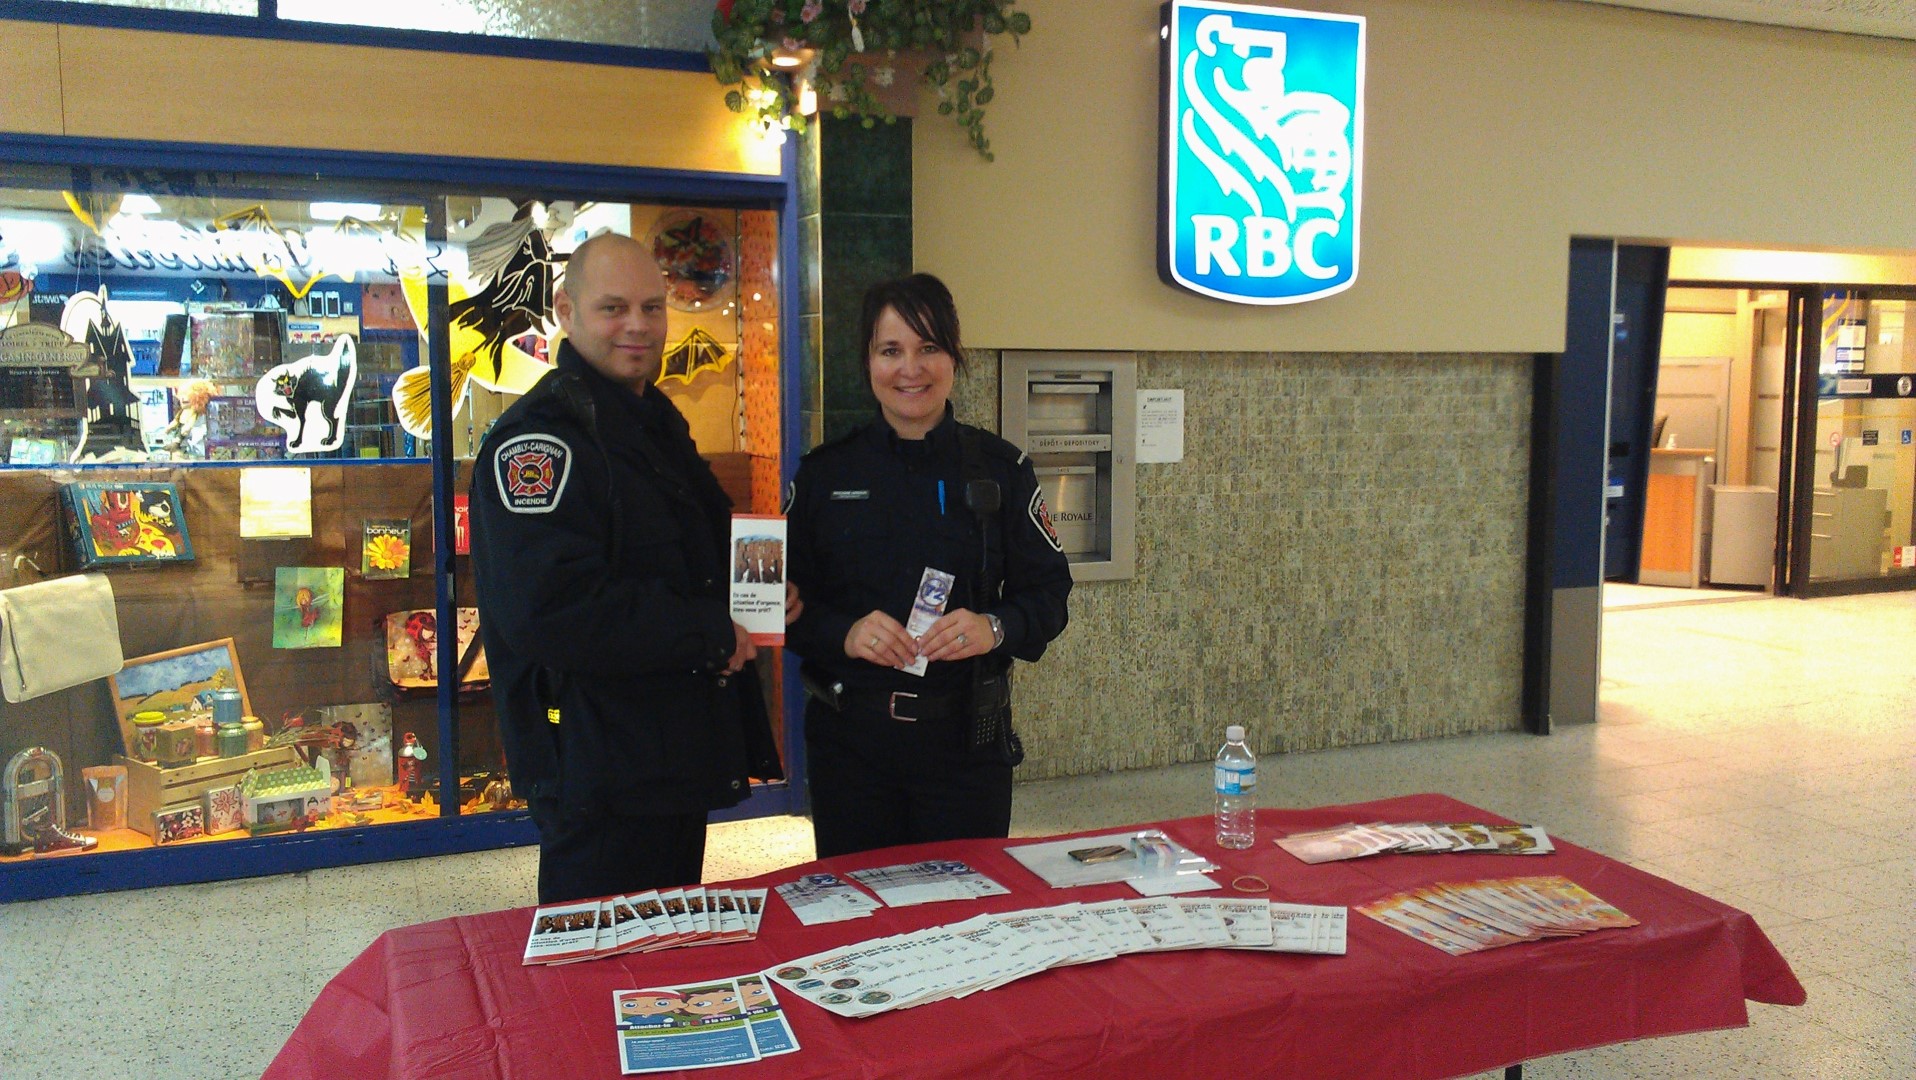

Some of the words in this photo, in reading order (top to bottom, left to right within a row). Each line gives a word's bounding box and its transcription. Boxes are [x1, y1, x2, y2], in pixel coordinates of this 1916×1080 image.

[1190, 213, 1340, 280] RBC
[1039, 438, 1058, 447] DÉPÔT
[1061, 512, 1093, 521] ROYALE
[366, 526, 409, 535] bonheur
[925, 584, 945, 600] 72
[704, 1055, 735, 1063] Québec
